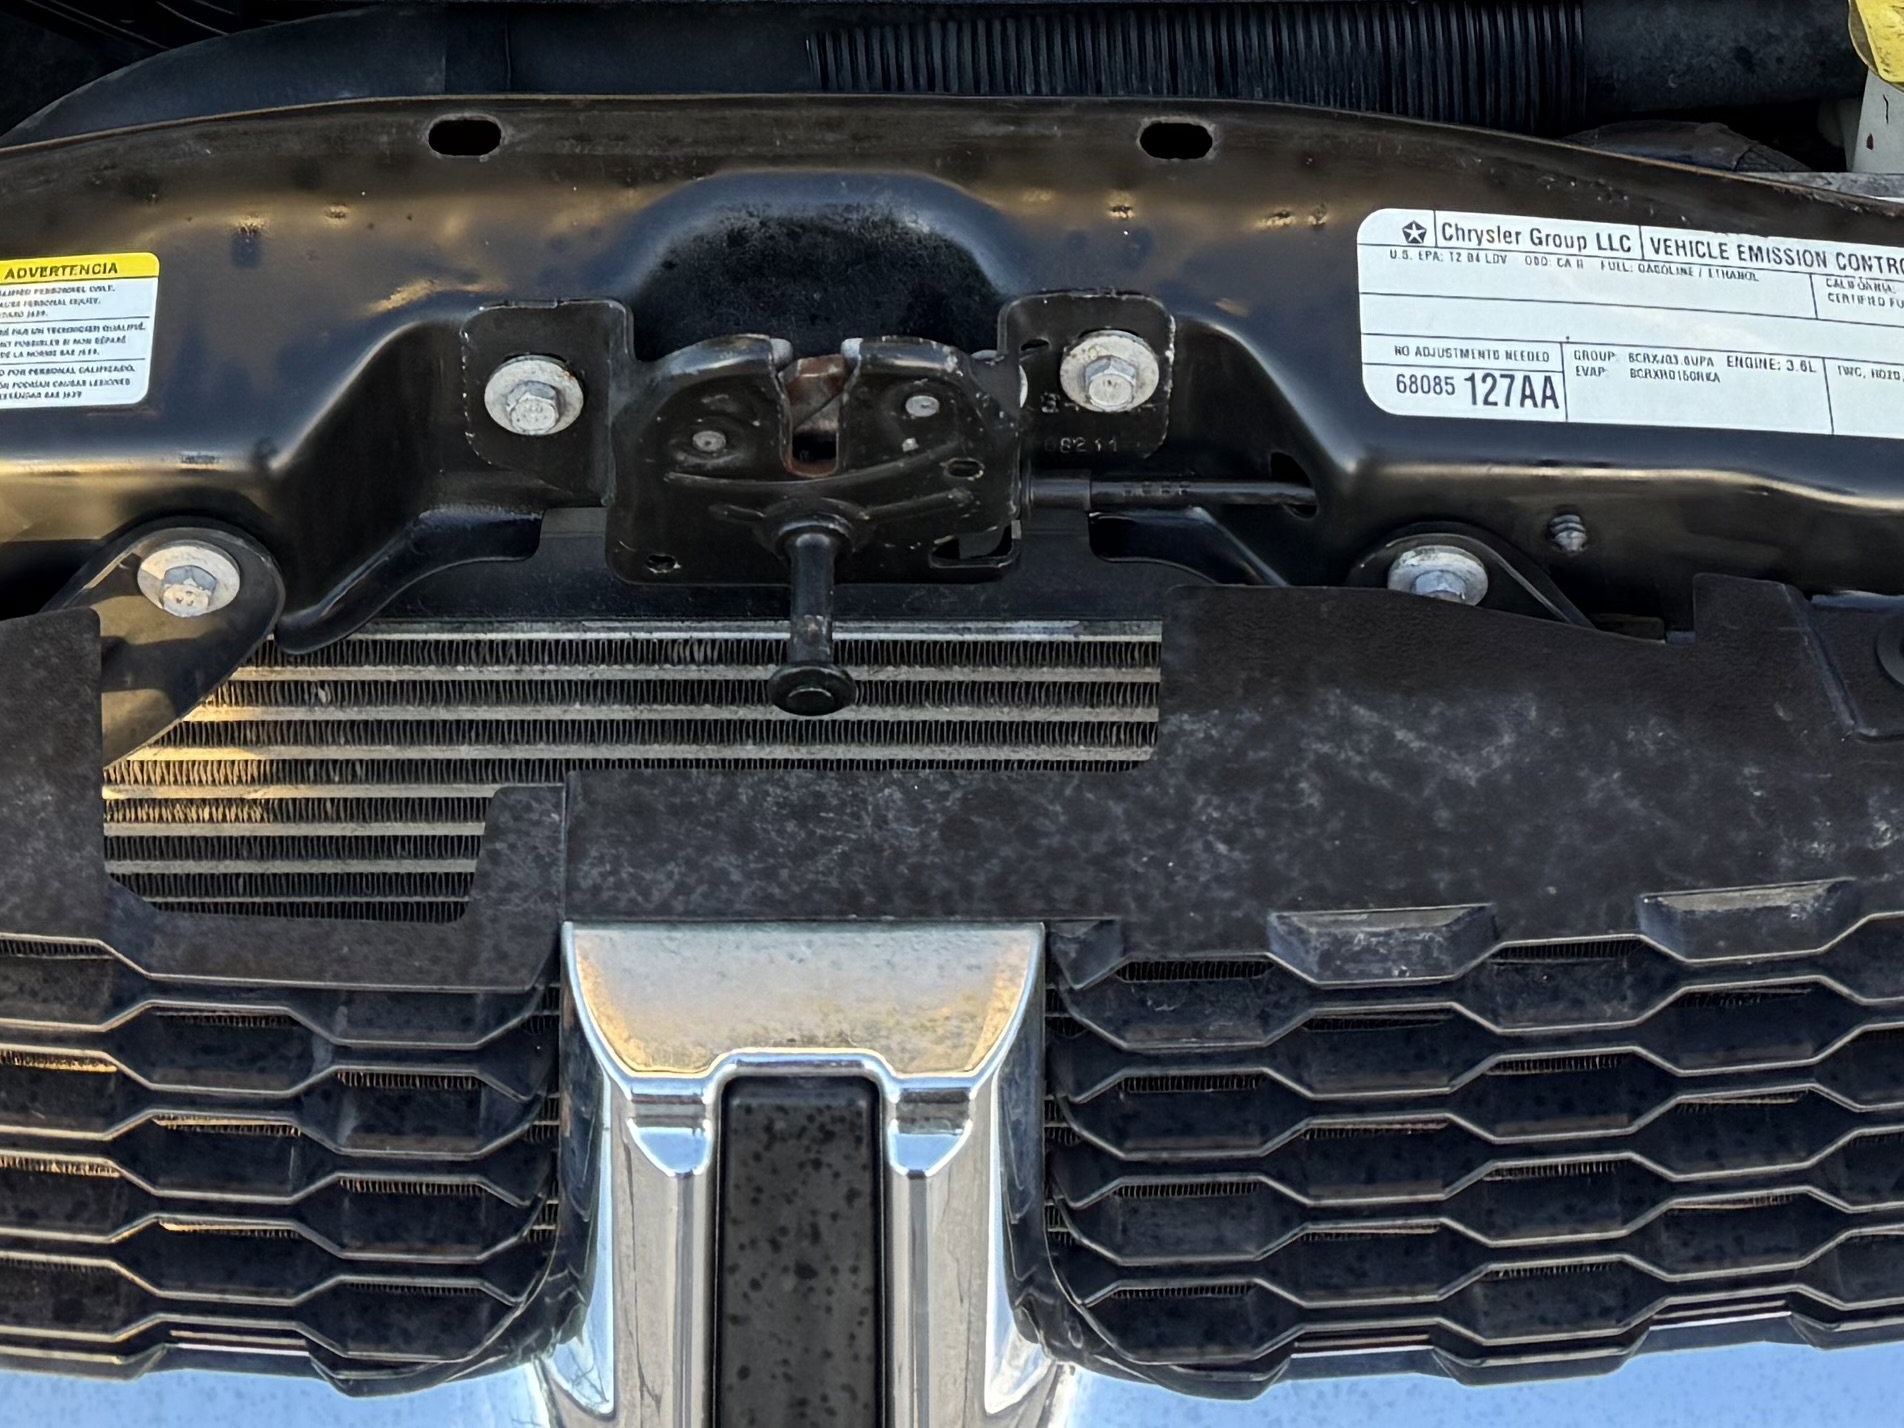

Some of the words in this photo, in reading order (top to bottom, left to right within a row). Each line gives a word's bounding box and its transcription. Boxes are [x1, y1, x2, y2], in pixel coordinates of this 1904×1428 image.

[1441, 222, 1522, 247] Chrysler
[1529, 228, 1588, 252] Group
[1596, 231, 1632, 253] LLC
[1649, 236, 1730, 261] VEHICLE
[1737, 244, 1828, 269] EMISSION
[3, 262, 119, 281] ADVERTENCIA
[1394, 345, 1410, 357] NO
[1504, 349, 1551, 363] NEEDED
[1395, 373, 1456, 396] 68085
[1463, 372, 1560, 410] 127AA
